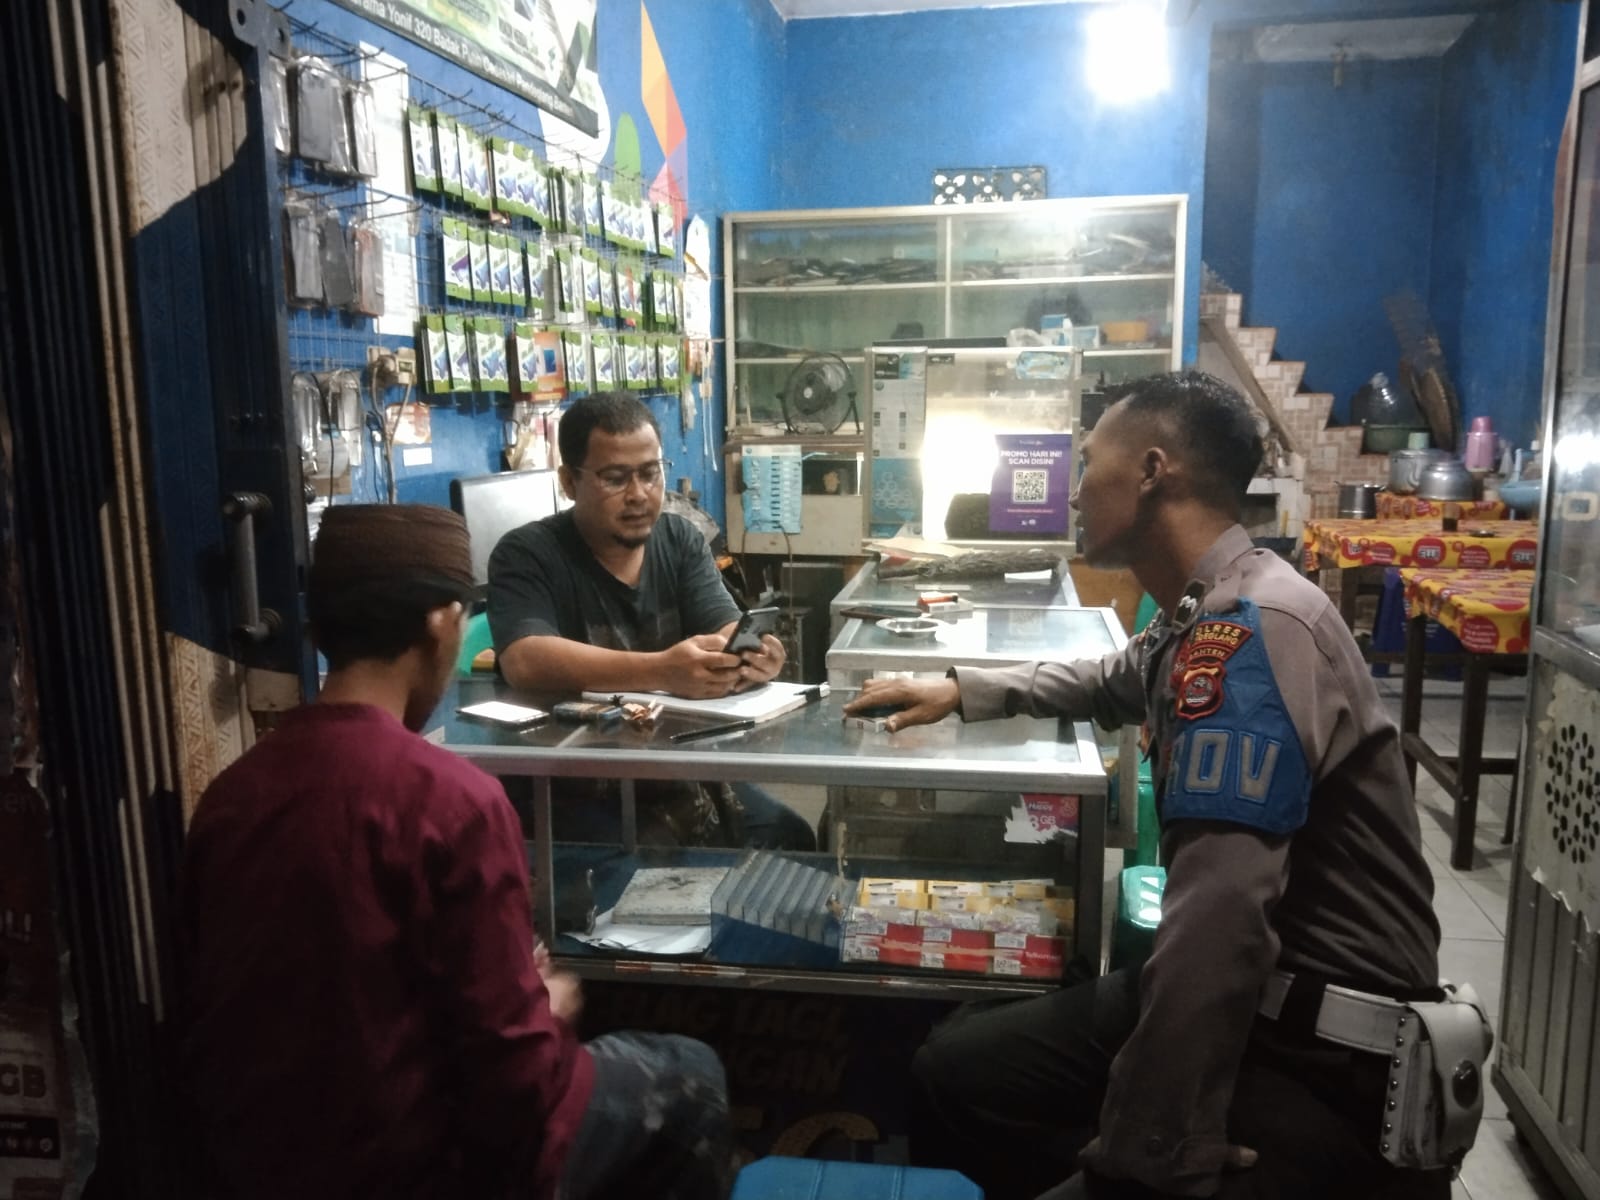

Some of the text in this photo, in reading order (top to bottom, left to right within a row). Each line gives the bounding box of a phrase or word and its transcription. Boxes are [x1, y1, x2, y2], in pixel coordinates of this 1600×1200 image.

[387, 3, 412, 31] Yonif
[414, 17, 432, 41] 320
[1000, 450, 1028, 458] PROMO
[1029, 450, 1049, 458] HARI
[1196, 624, 1241, 638] OLRES
[1191, 648, 1226, 658] ANTEN
[1028, 801, 1054, 812] Happy
[1040, 815, 1057, 825] GB
